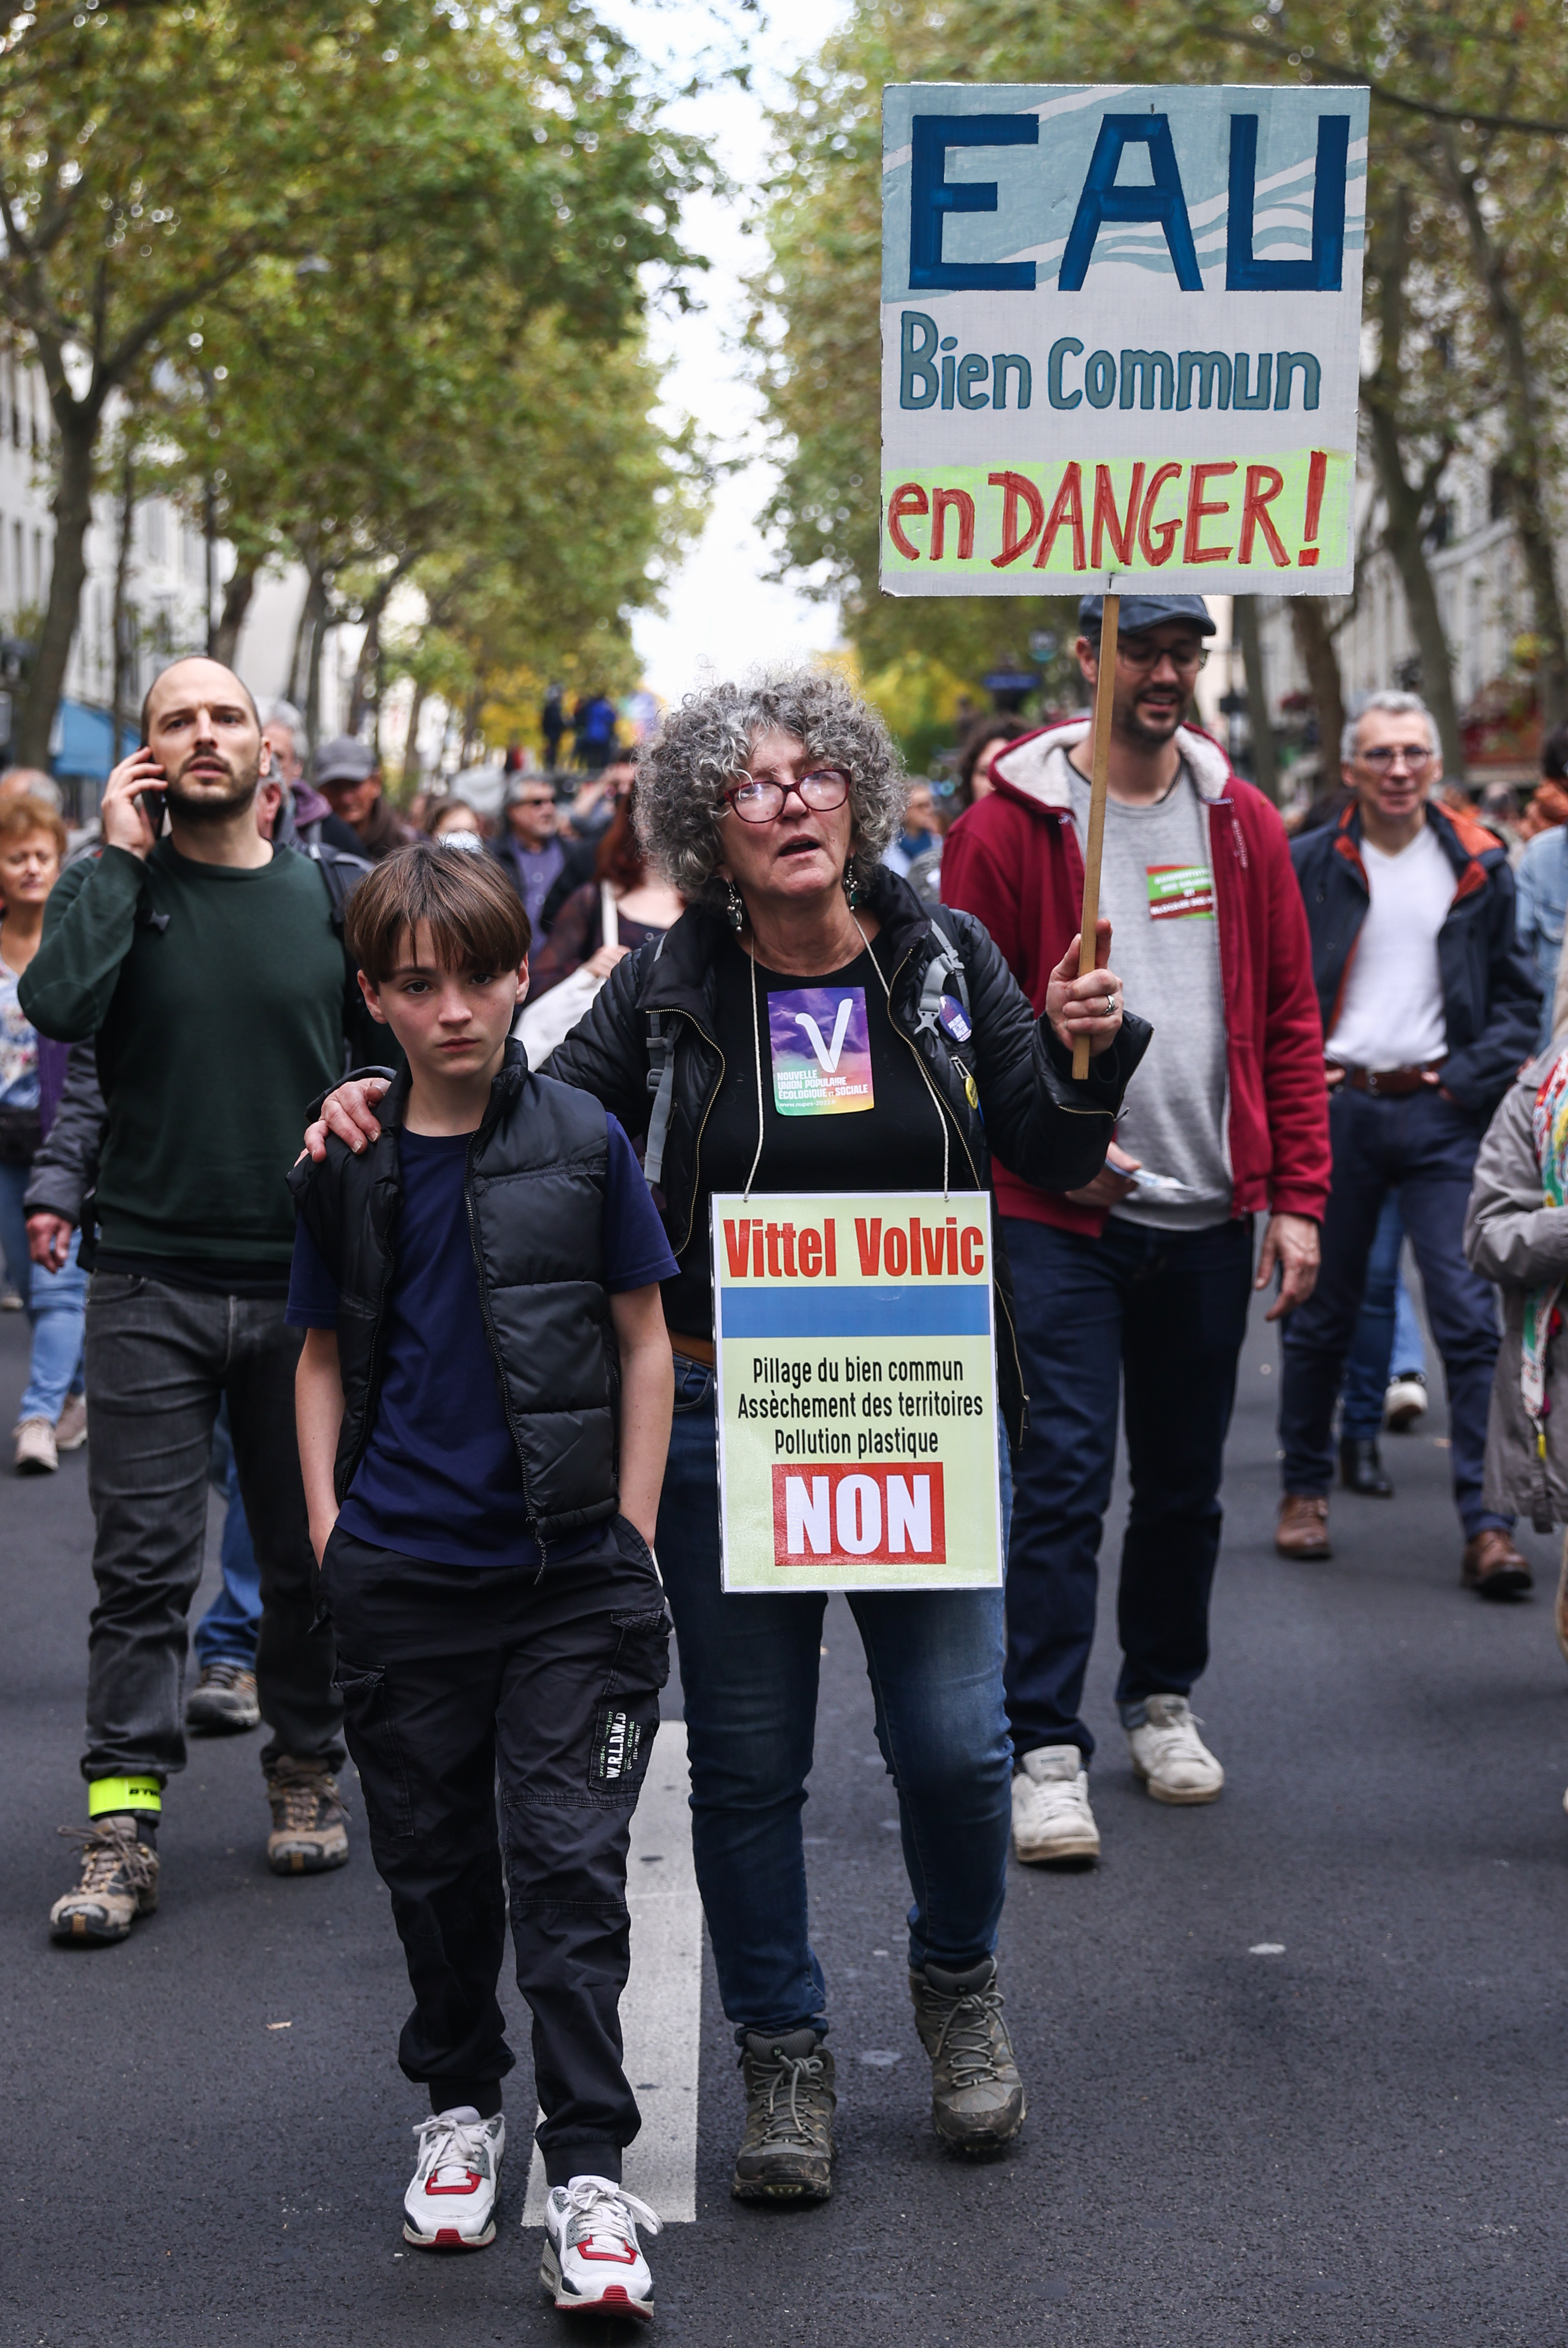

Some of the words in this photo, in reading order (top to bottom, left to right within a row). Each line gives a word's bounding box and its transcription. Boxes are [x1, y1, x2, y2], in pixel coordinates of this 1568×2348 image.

[908, 113, 1350, 292] EAU
[899, 310, 1032, 411] Bien
[1048, 337, 1322, 412] Commun
[887, 482, 976, 561] en
[988, 451, 1328, 571] DANGER!
[777, 1070, 818, 1081] NOUVELLE
[777, 1080, 802, 1090] UNION
[804, 1076, 847, 1088] POPULAIRE
[778, 1088, 827, 1100] ÉCOLOGIQUE
[835, 1084, 868, 1096] SOCIALE
[723, 1218, 837, 1278] Vittel
[854, 1217, 984, 1277] Volvic
[753, 1357, 812, 1389] Pillage
[817, 1356, 839, 1382] du
[845, 1355, 882, 1382] bien
[888, 1359, 964, 1382] commun
[738, 1389, 856, 1419] Assèchement
[862, 1392, 892, 1417] des
[898, 1390, 983, 1416] territoires
[774, 1427, 851, 1455] Pollution
[857, 1426, 939, 1460] plastique
[784, 1473, 932, 1556] NON
[606, 1712, 626, 1778] W.R.L.D.W.D
